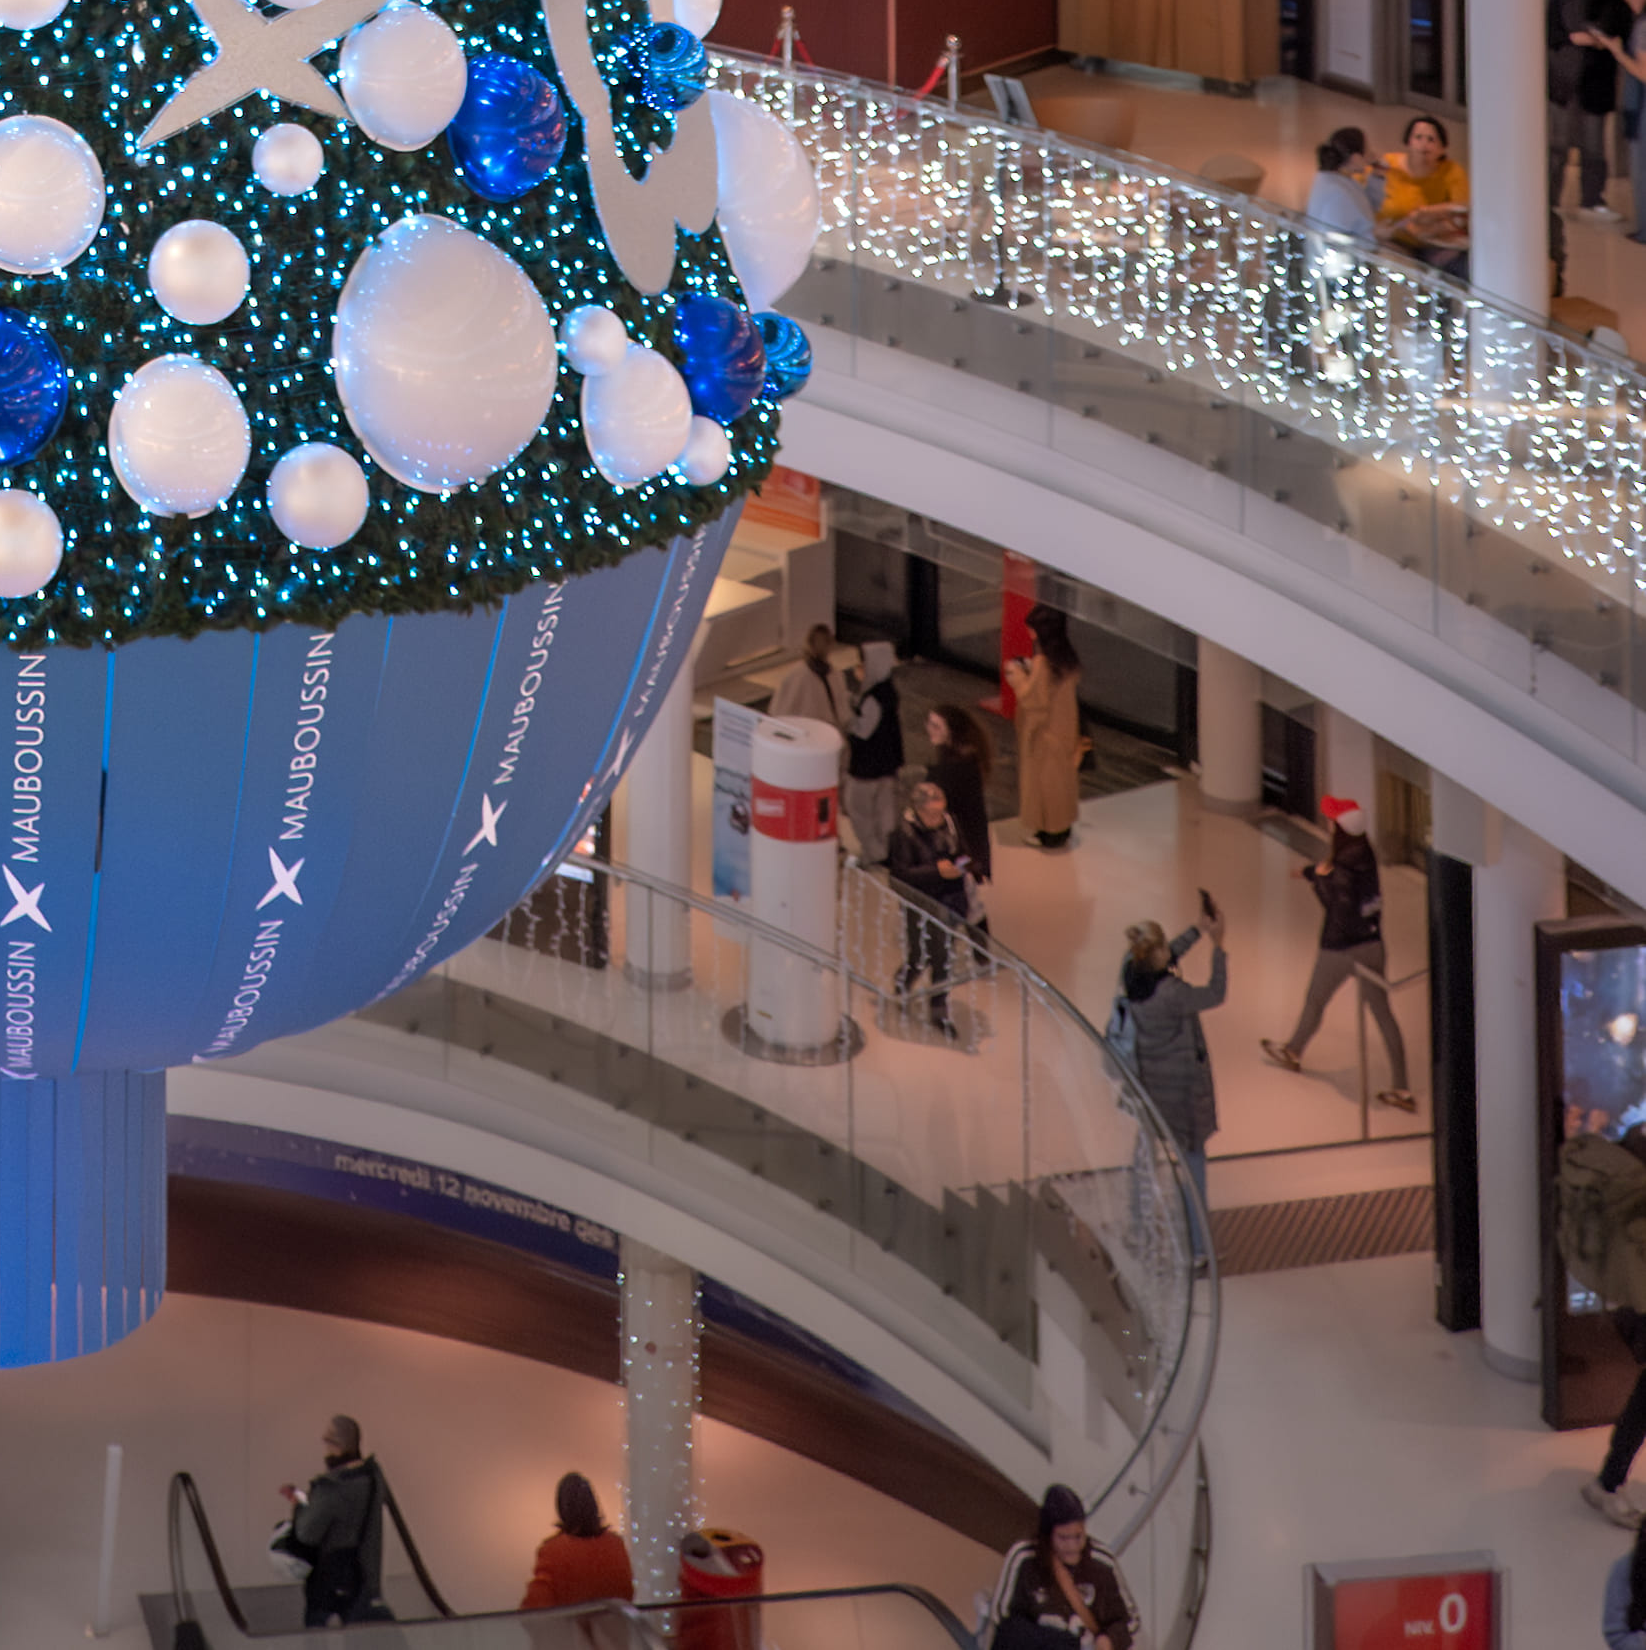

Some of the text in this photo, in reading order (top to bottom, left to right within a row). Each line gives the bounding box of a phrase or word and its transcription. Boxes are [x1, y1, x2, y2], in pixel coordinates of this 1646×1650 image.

[11, 654, 48, 863] MAUBOUSSIN
[280, 632, 336, 841] MAUBOUSSIN
[493, 577, 569, 786] MAUBOUSSIN
[6, 941, 36, 1069] MAUBOUSSIN
[334, 1154, 430, 1190] mercredi
[438, 1175, 461, 1199] 12
[463, 1183, 572, 1232] novembre
[1438, 1592, 1468, 1634] 0
